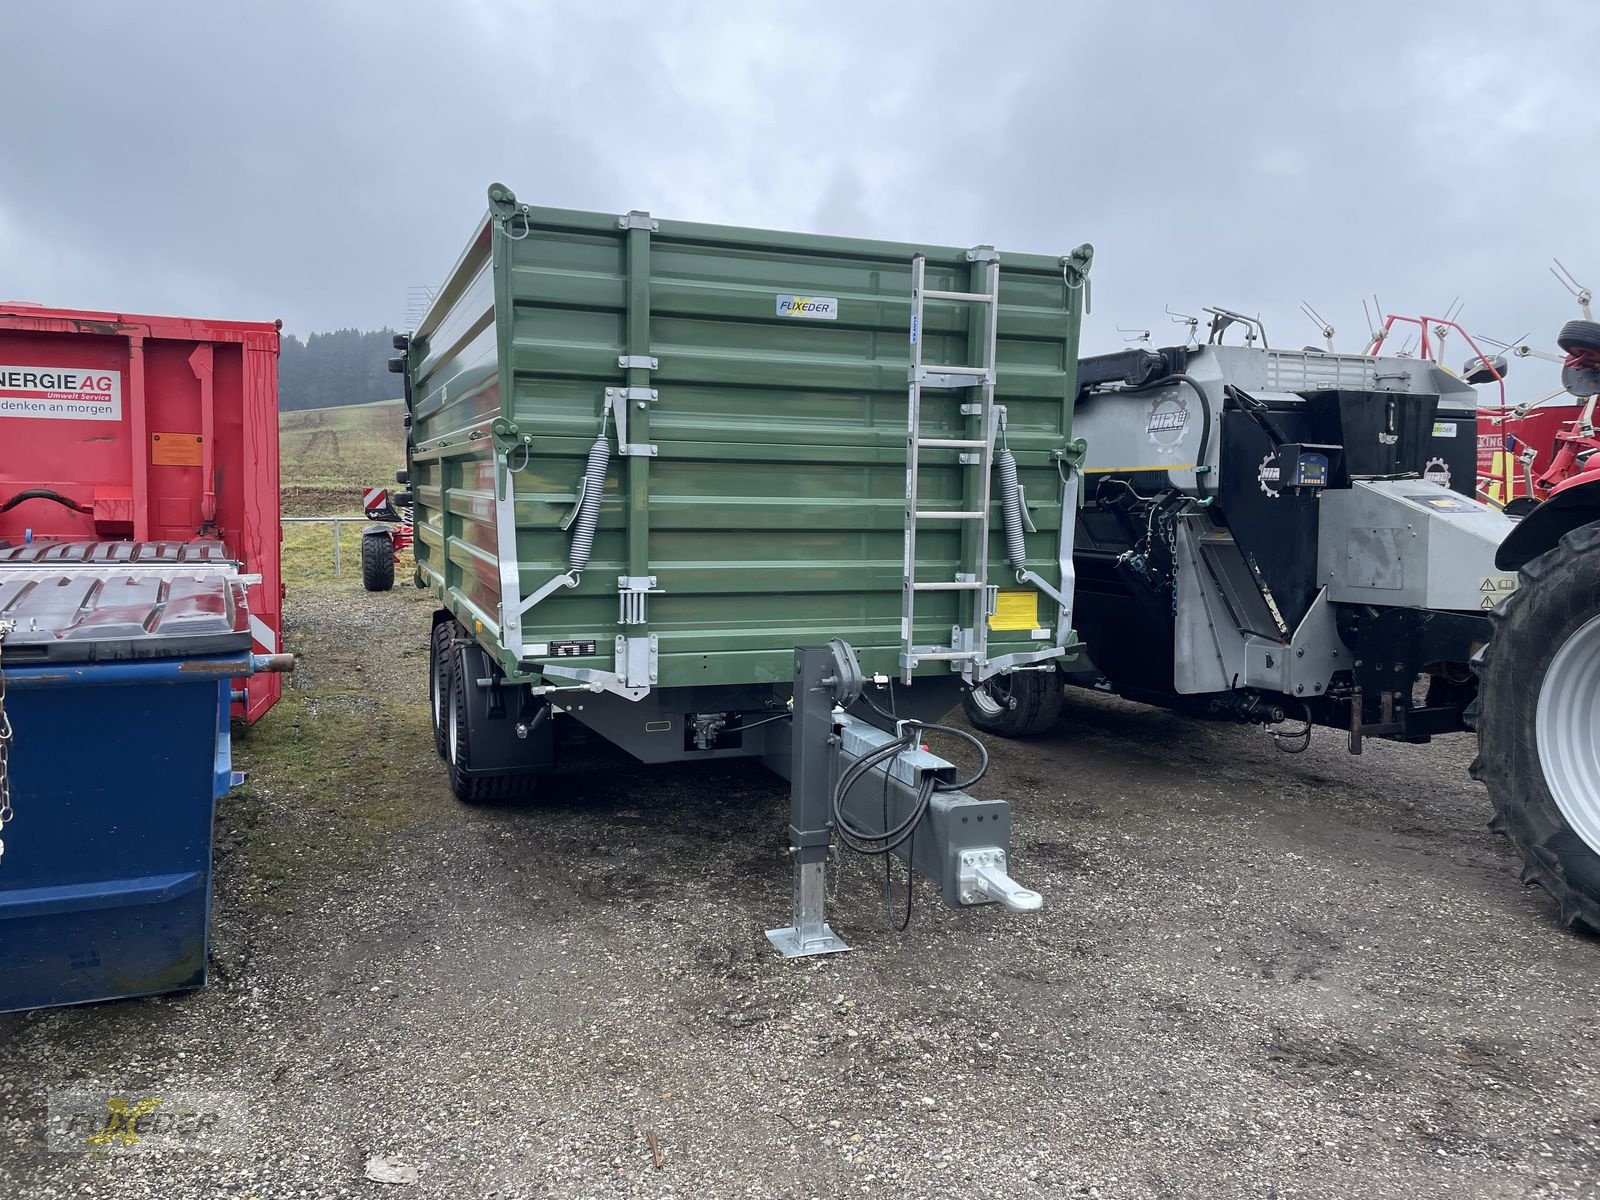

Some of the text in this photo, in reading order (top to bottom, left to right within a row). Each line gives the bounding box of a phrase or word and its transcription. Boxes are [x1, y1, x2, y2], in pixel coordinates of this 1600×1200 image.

[780, 301, 830, 312] FLIXEDER
[79, 376, 112, 391] AG
[47, 391, 110, 401] Umwelt Service
[1, 401, 112, 415] denken an morgen
[1477, 437, 1503, 447] KING
